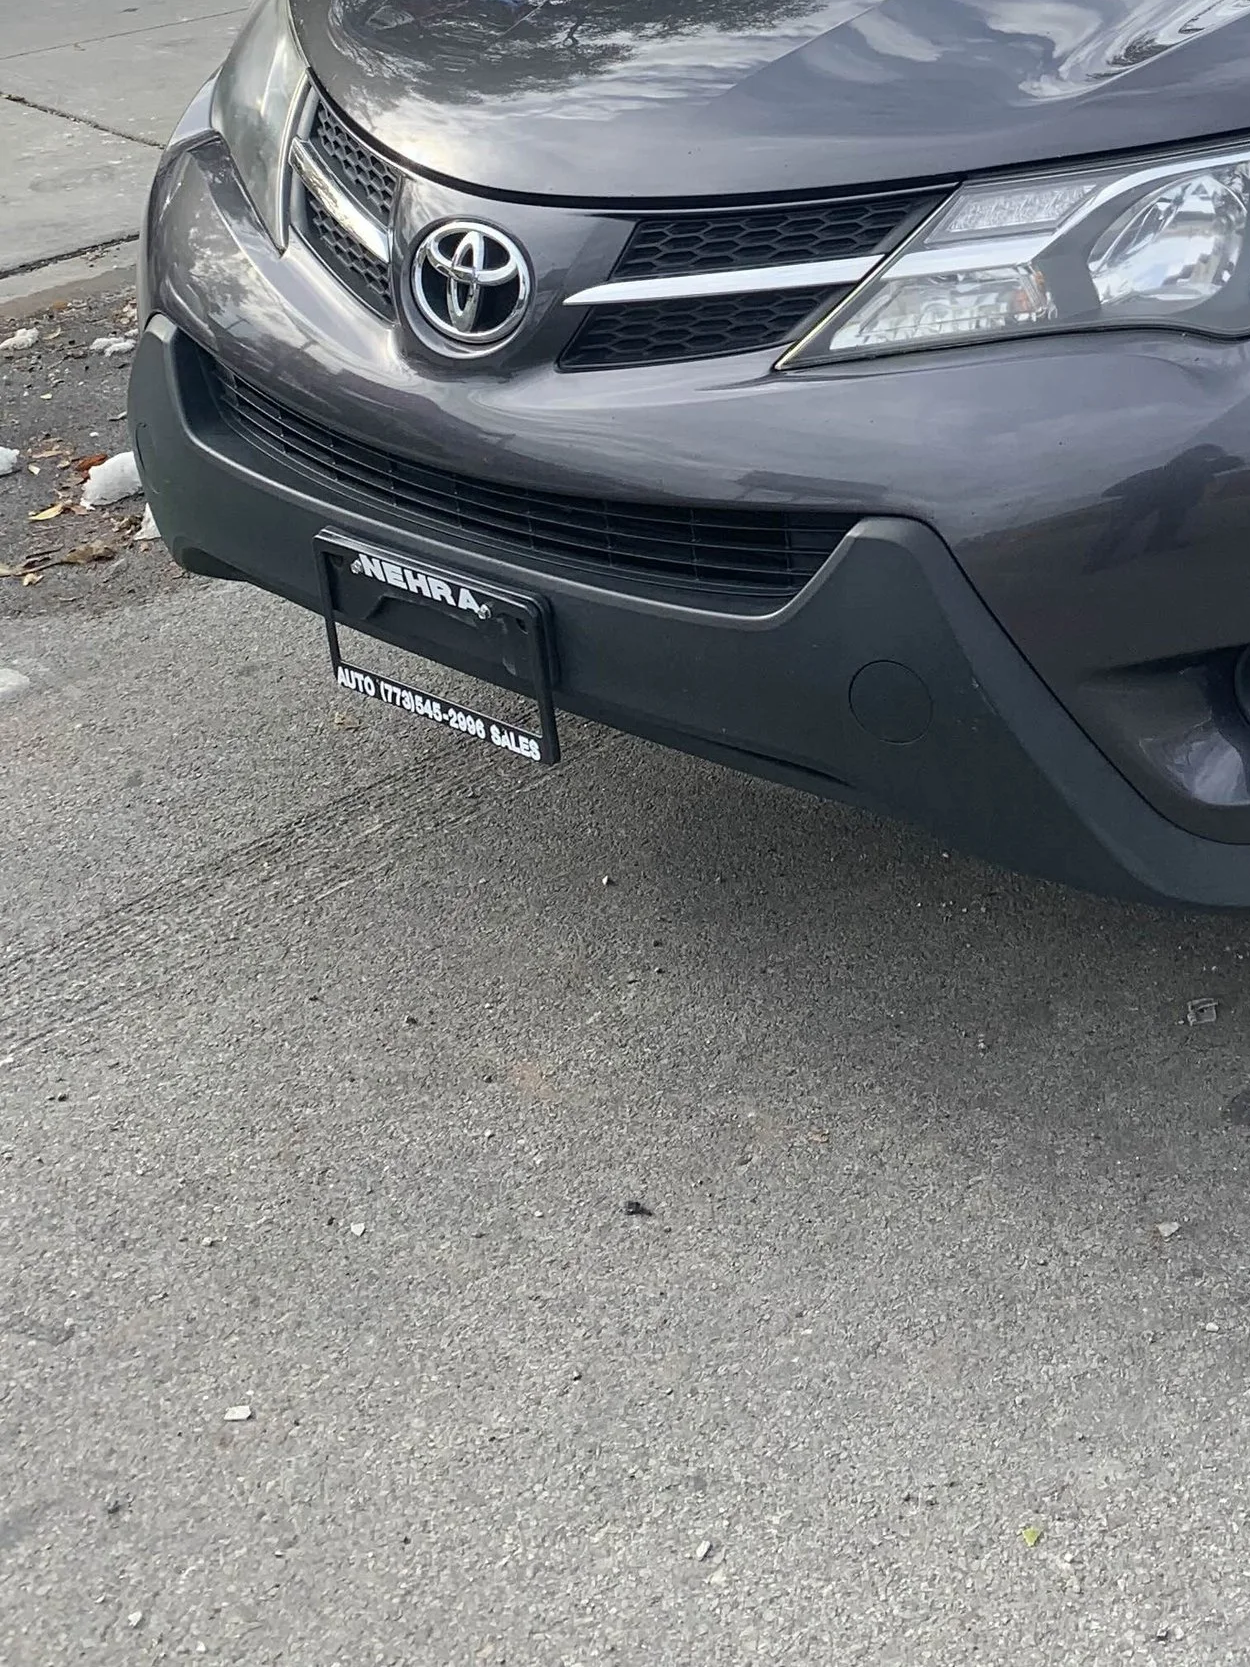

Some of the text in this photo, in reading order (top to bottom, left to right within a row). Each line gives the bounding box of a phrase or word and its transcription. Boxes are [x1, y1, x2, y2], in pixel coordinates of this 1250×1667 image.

[358, 553, 480, 614] NEHRA
[338, 666, 375, 696] AUTO
[490, 724, 541, 761] SALES
